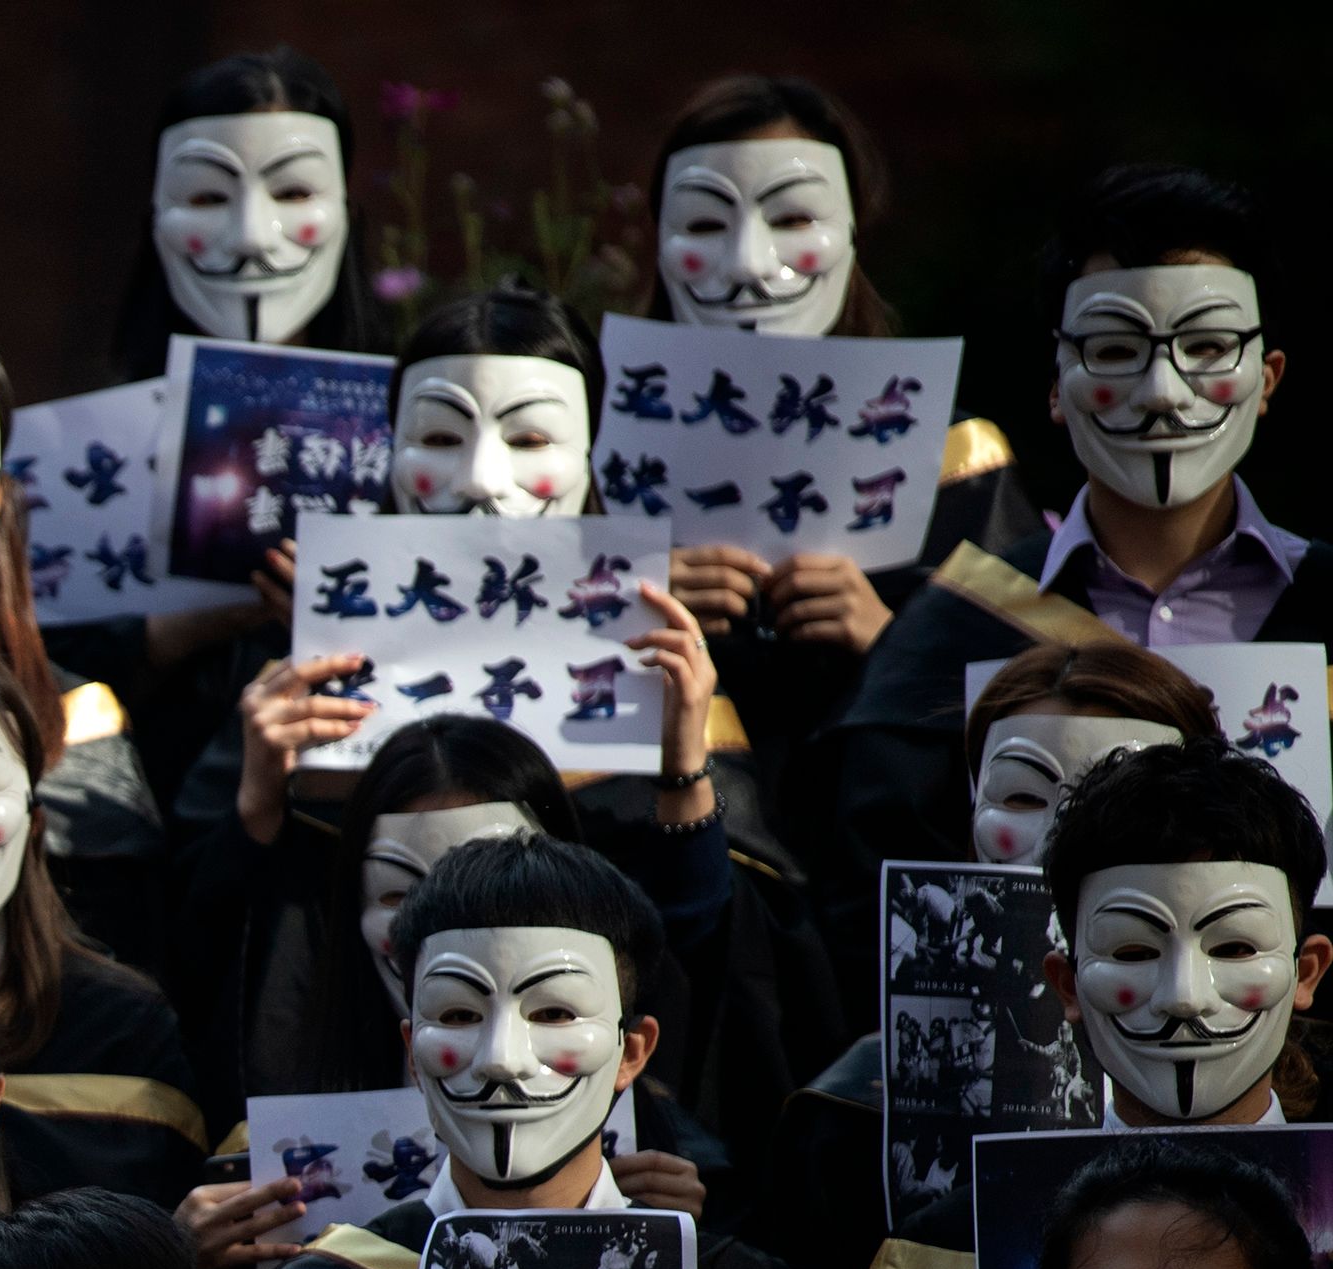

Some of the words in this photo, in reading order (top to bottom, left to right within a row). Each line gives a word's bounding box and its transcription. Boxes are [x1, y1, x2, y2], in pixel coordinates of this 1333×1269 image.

[611, 361, 923, 444] 五大訴求
[602, 448, 908, 534] 缺一不可
[311, 553, 632, 628] 五大訴求
[1203, 681, 1302, 758] 求
[554, 1224, 611, 1236] 2019.6.14
